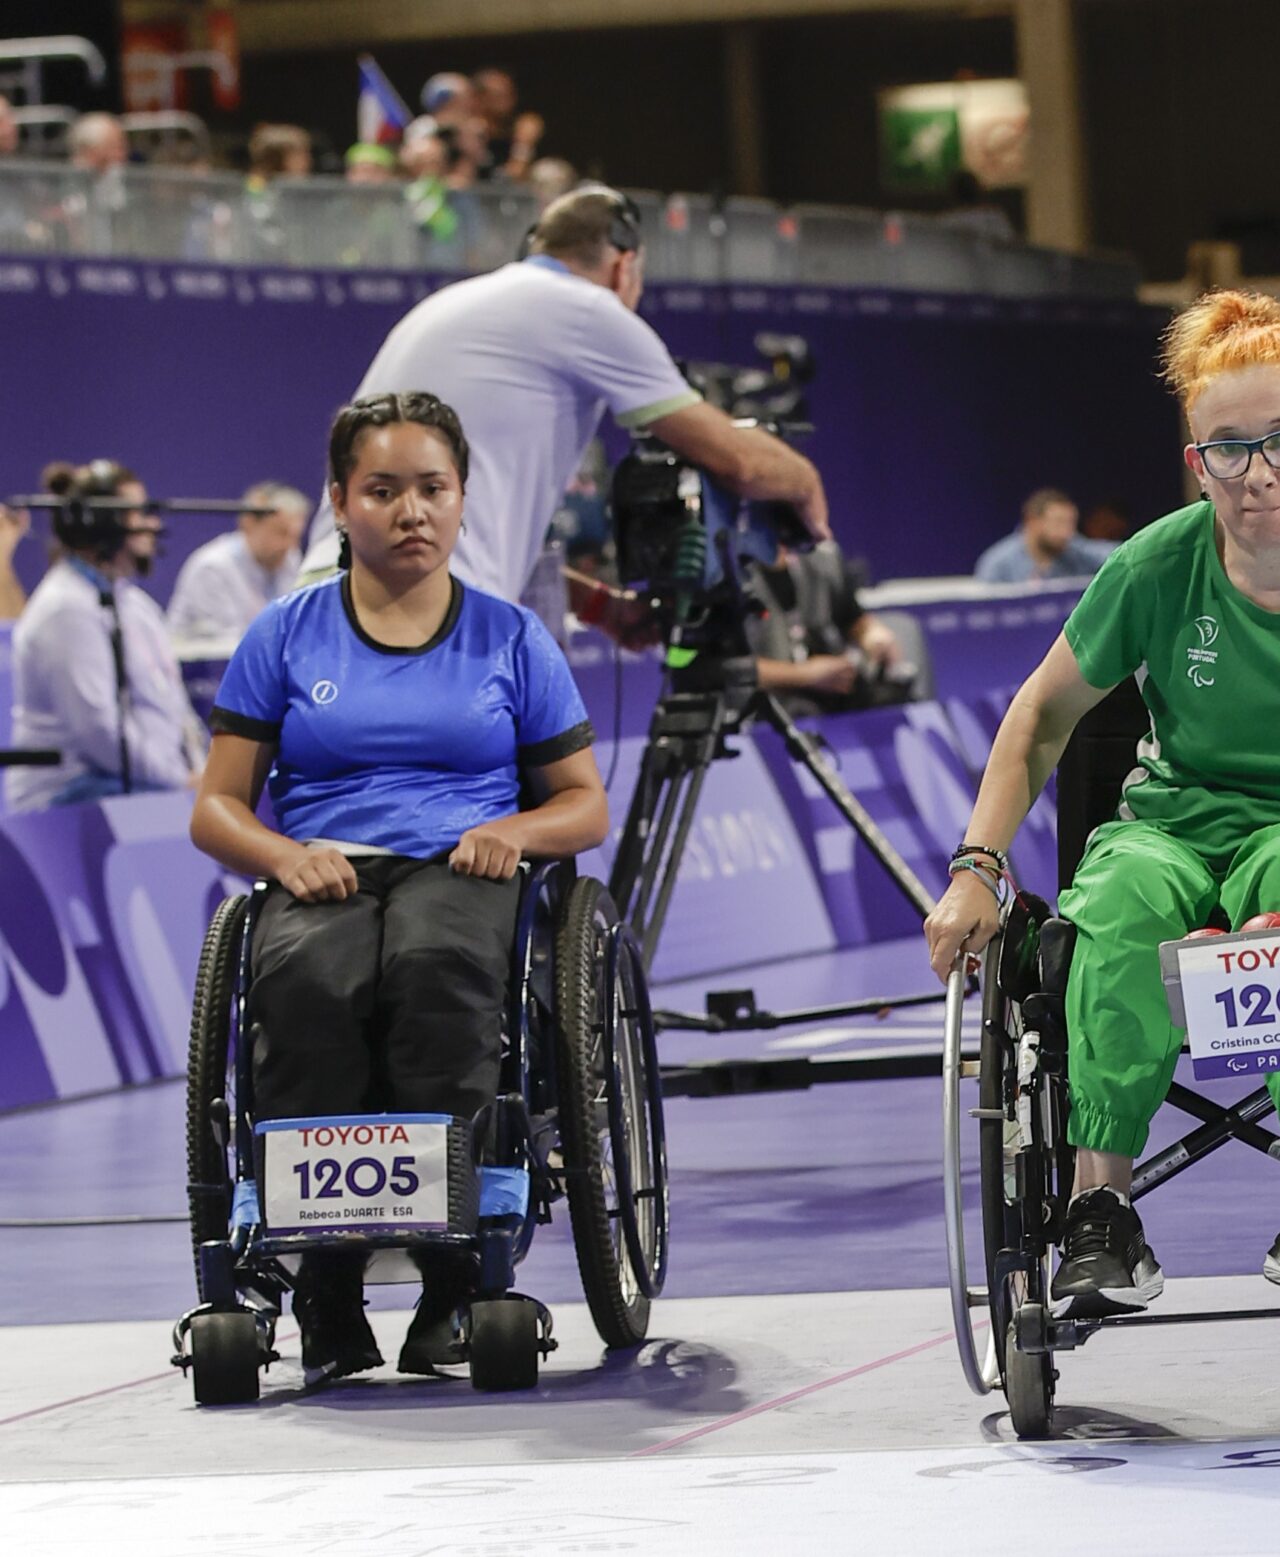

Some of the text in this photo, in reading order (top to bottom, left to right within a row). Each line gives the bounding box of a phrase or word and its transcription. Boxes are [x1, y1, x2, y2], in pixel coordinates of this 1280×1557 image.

[1210, 1037, 1260, 1050] Cristina
[298, 1125, 409, 1147] TOYOTA
[293, 1156, 419, 1200] 1205
[299, 1206, 413, 1220] Rebeca DUARTE ESA
